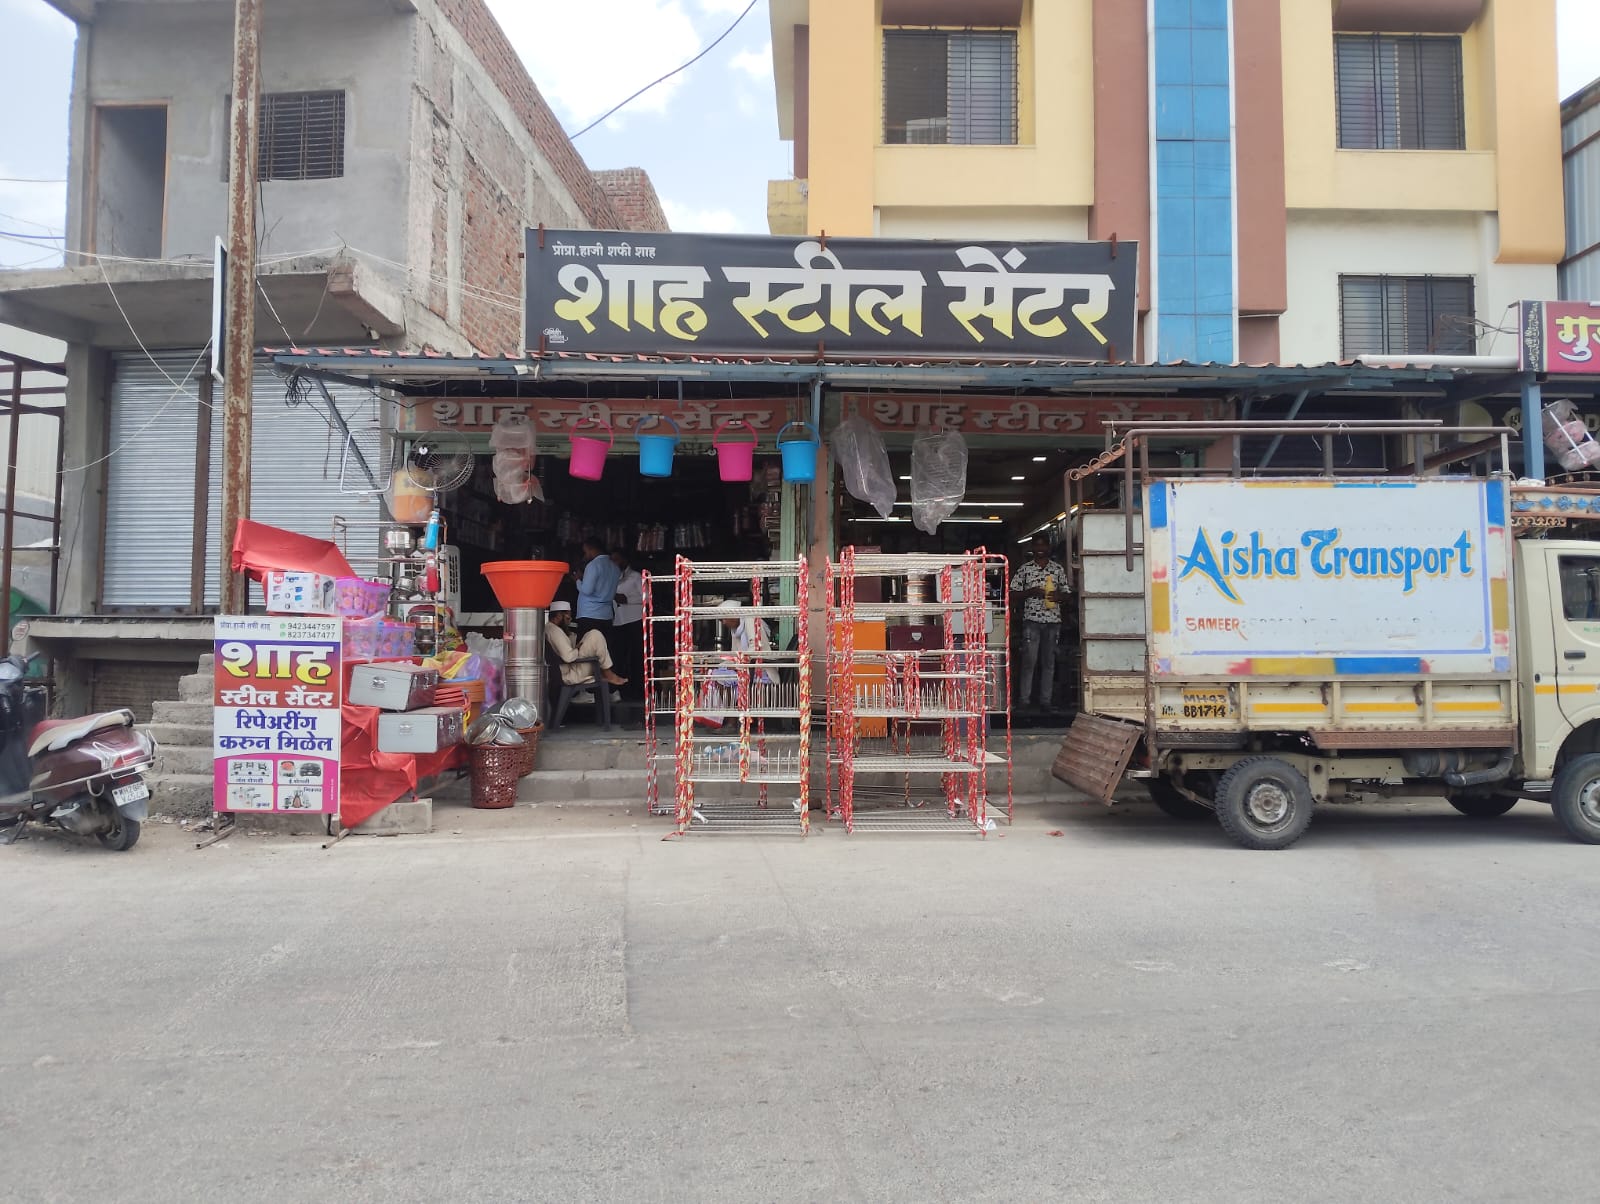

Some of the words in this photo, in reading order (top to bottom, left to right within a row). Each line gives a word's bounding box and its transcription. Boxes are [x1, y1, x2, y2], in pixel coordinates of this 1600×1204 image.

[607, 242, 632, 257] शफी
[634, 246, 657, 259] शाह
[554, 263, 712, 341] शाह
[721, 240, 928, 339] स्टील
[937, 245, 1116, 345] सेंटर
[1555, 315, 1600, 362] गु
[671, 402, 774, 430] सेंटर
[873, 400, 967, 432] शाह
[971, 400, 1088, 431] स्टील
[1178, 525, 1298, 604] Aisha
[1301, 527, 1474, 593] Transport
[220, 642, 334, 685] शाह
[220, 684, 279, 706] स्टील
[285, 685, 334, 707] सेंटर
[219, 735, 271, 750] करुन
[277, 731, 334, 751] मिळेल
